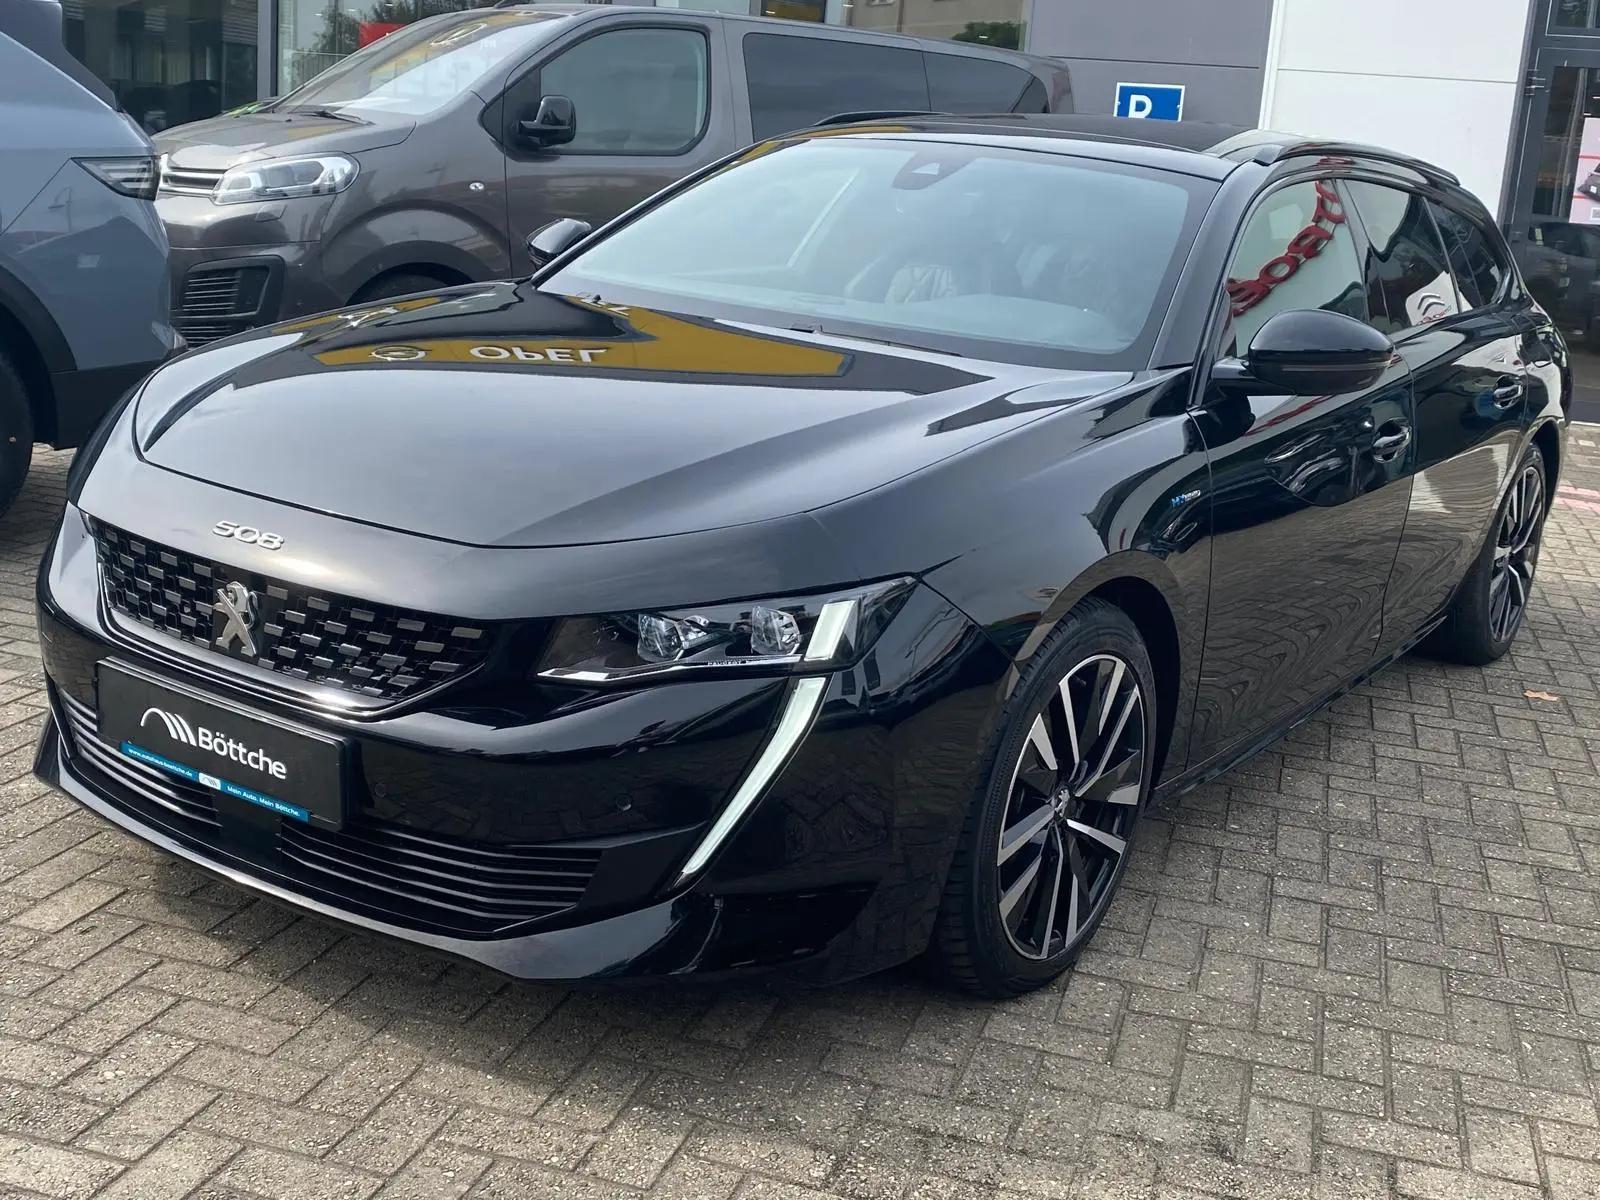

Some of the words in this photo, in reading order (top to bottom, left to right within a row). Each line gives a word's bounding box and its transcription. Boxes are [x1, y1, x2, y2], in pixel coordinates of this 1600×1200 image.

[1128, 94, 1152, 118] P
[212, 520, 284, 550] 508
[197, 726, 287, 780] Böttche
